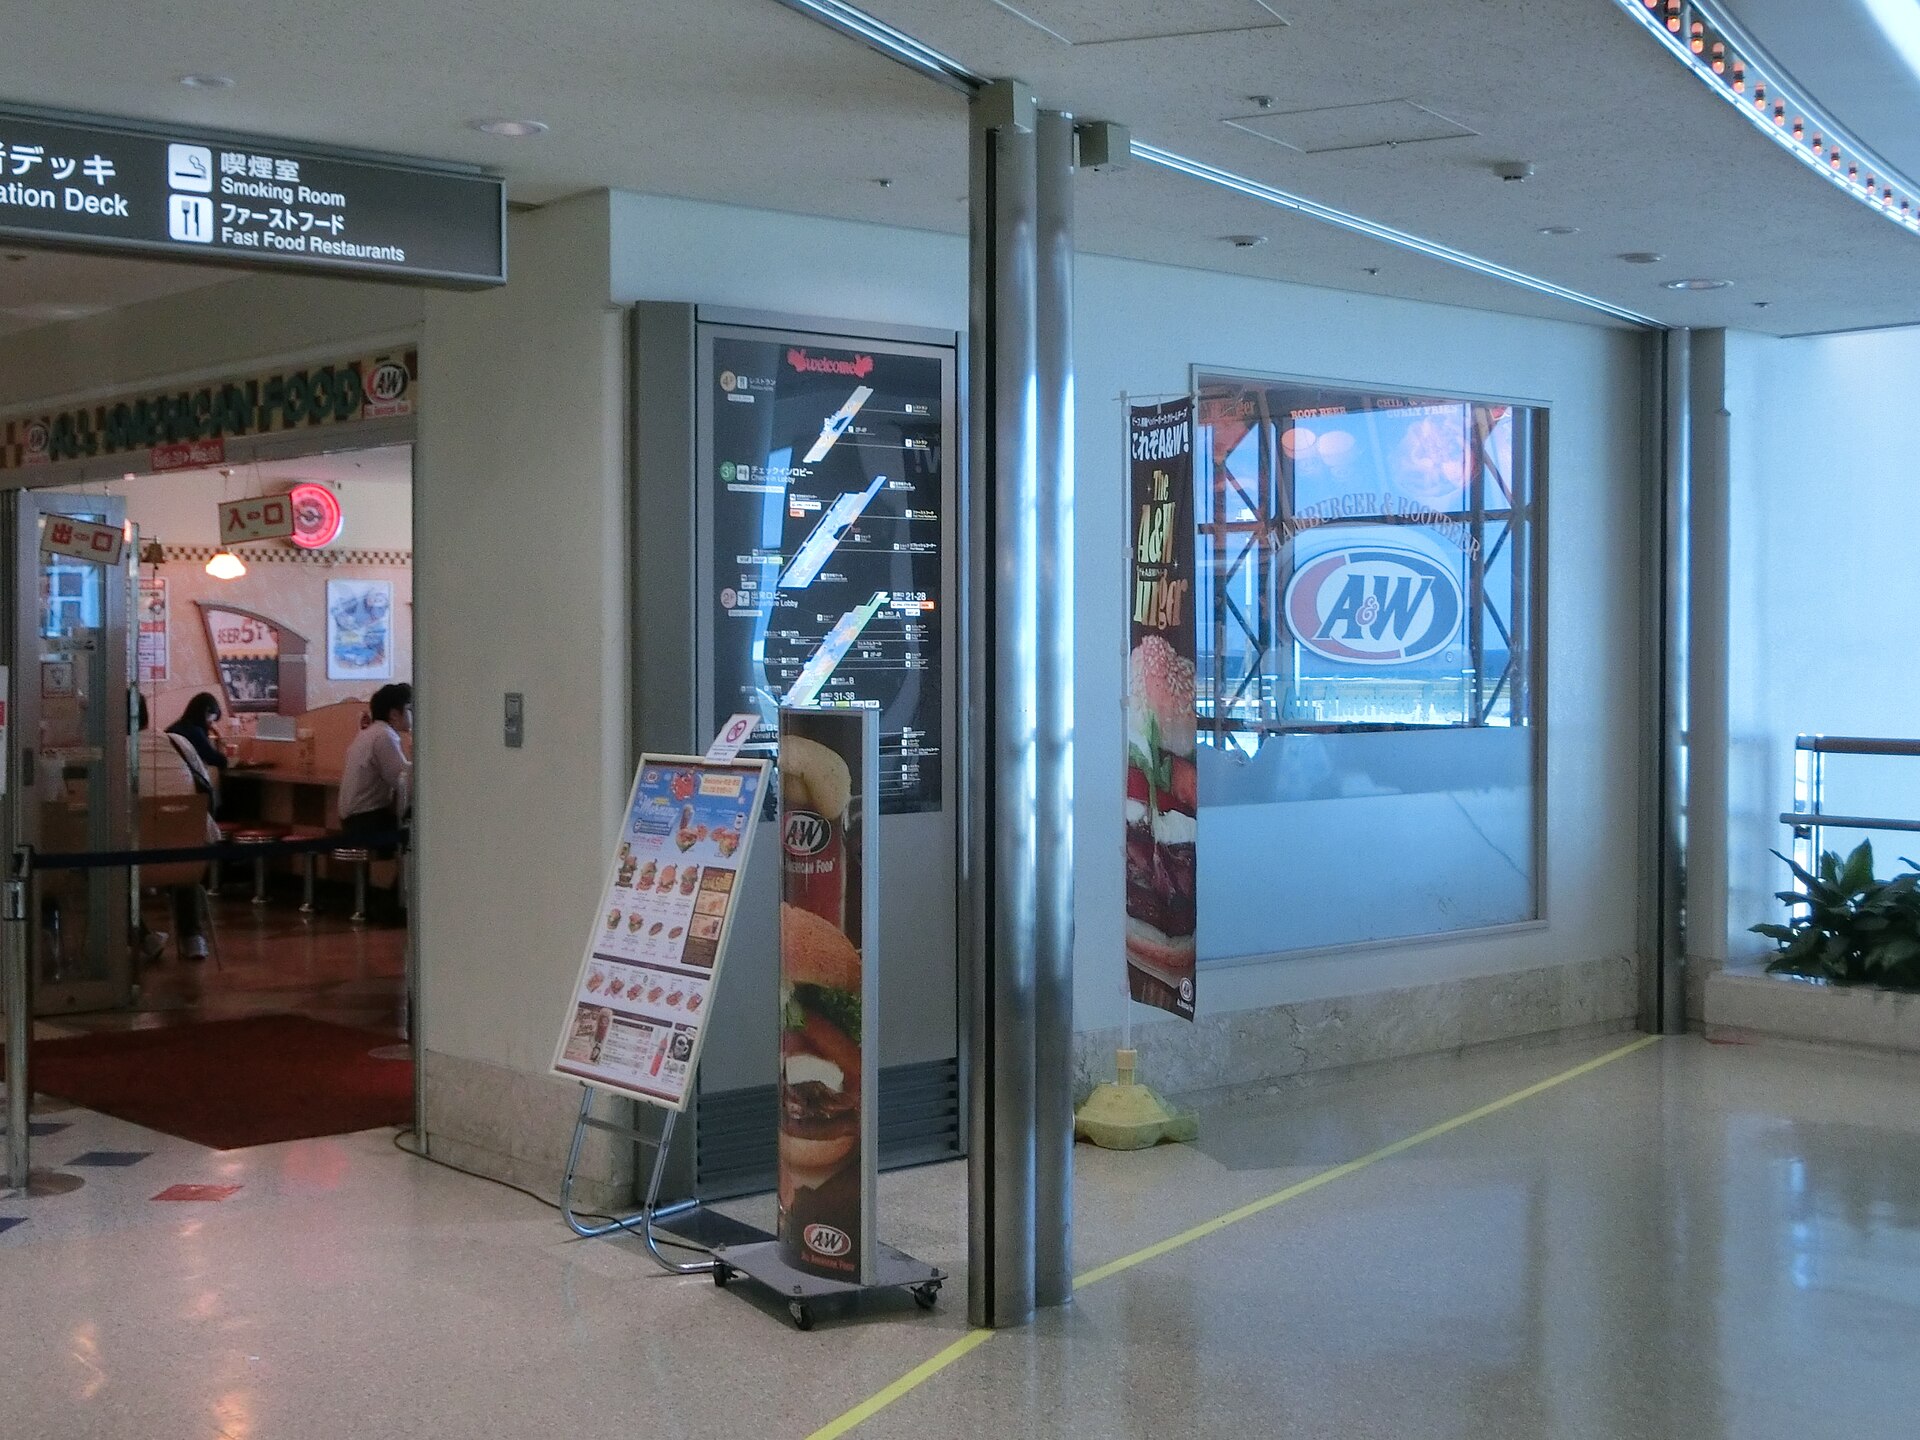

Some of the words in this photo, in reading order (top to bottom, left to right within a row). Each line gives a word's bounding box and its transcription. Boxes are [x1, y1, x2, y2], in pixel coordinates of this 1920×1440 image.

[0, 141, 117, 187] デッキ
[220, 151, 300, 183] 喫煙室
[64, 186, 130, 217] Deck
[221, 176, 293, 206] Smoking
[297, 185, 346, 208] Room
[221, 202, 345, 236] ファーストフード
[221, 227, 260, 248] Fast
[263, 231, 306, 252] Food
[310, 236, 406, 262] Restaurants
[259, 368, 363, 431] FOOD
[1290, 408, 1319, 420] ROOT
[1152, 469, 1170, 501] The
[1267, 492, 1378, 552] HAMBURGER
[1380, 492, 1393, 516] &
[780, 600, 799, 609] Lobby
[1312, 573, 1435, 642] A&W
